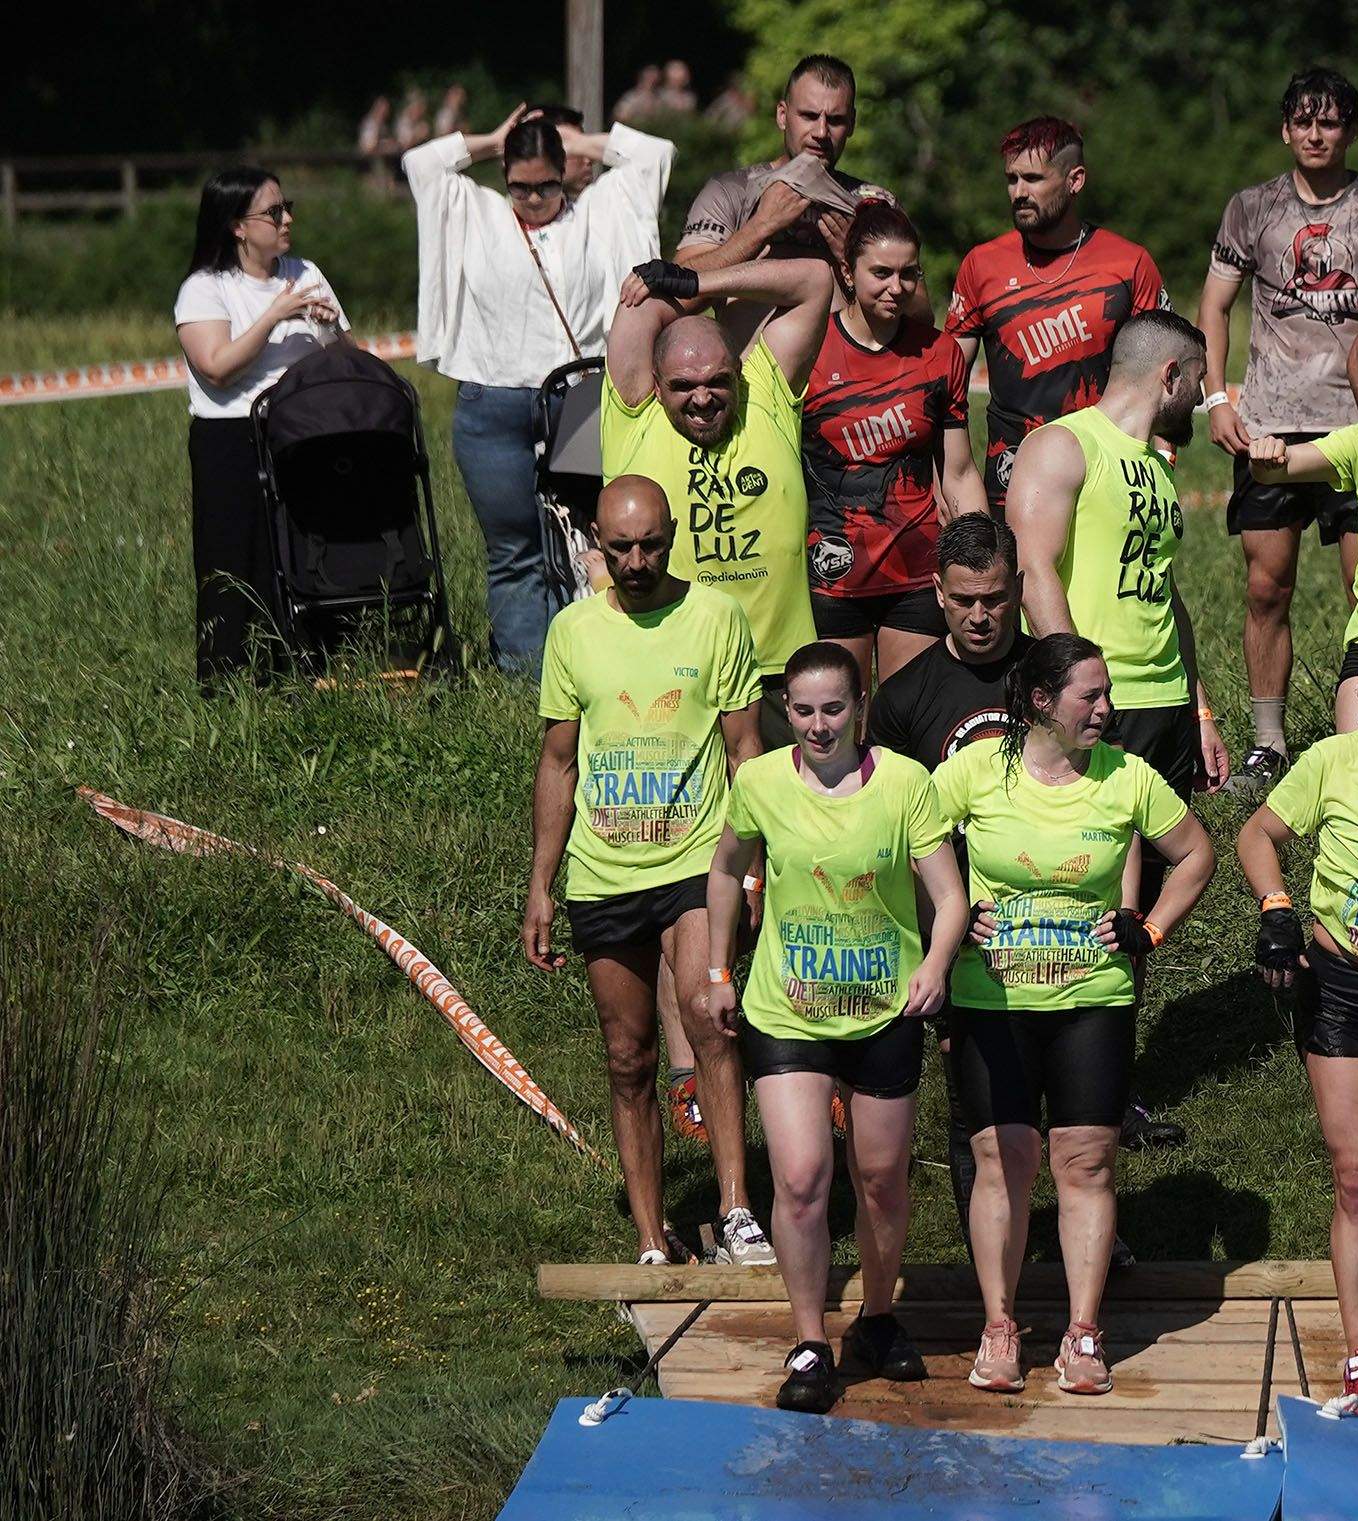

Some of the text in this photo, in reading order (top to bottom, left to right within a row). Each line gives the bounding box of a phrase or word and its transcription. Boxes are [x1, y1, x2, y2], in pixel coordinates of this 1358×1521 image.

[1016, 304, 1093, 366] LUME
[841, 402, 917, 462] LUME
[1120, 458, 1156, 494] UN
[689, 502, 737, 534] DE
[693, 529, 762, 564] LUZ
[1120, 529, 1161, 568] DE
[1116, 565, 1168, 603] LUZ
[673, 666, 699, 678] VICTOR
[625, 736, 661, 747] ACTIVITY
[592, 807, 621, 827] DIET
[630, 808, 662, 820] ATHLETE
[607, 820, 671, 843] MUSCLE LIFE
[999, 897, 1033, 917] ALTH
[780, 919, 834, 946] HEALTH
[998, 918, 1096, 948] RAINER
[785, 944, 892, 983] TRAINER
[1025, 950, 1061, 961] ATHLETE
[1061, 948, 1099, 963] HEALTH
[1001, 962, 1071, 984] MUSCLE LIFE
[786, 977, 897, 1001] DIET ATHLETE HEALTH
[804, 995, 871, 1019] MUSCLE LIFE
